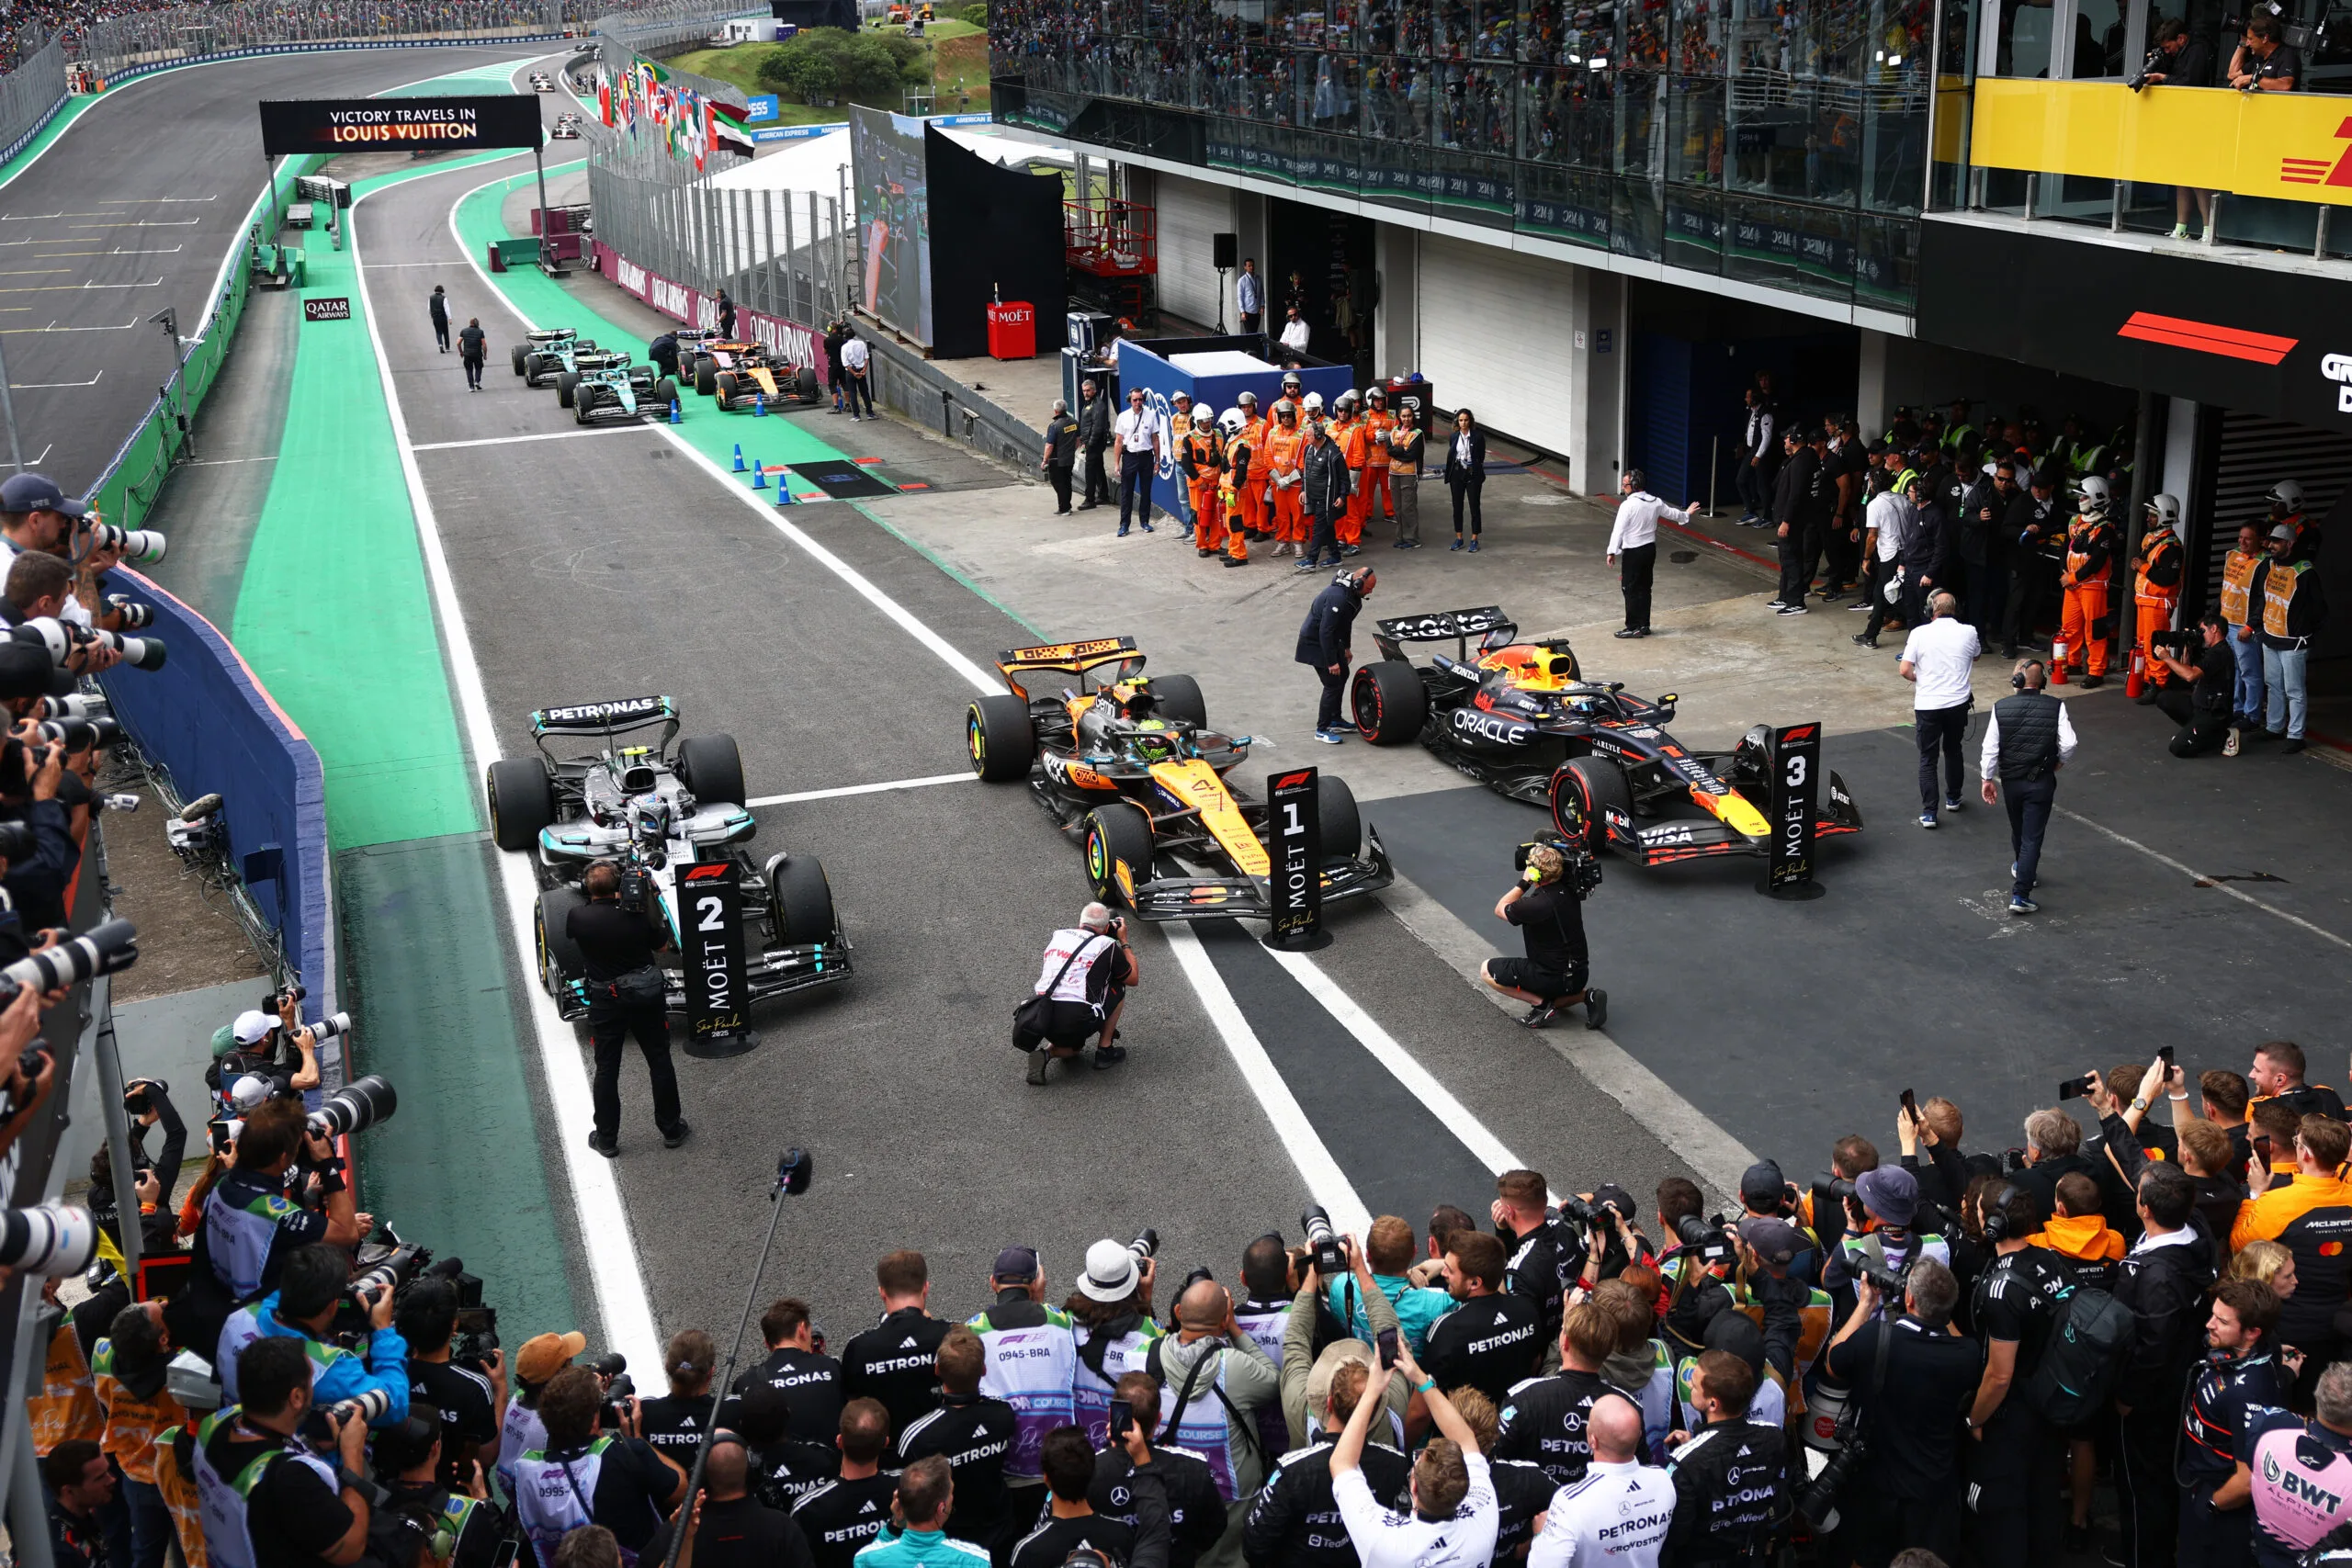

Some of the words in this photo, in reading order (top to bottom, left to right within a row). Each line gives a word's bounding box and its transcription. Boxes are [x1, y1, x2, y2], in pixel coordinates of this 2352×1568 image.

[330, 110, 391, 124] VICTORY
[396, 108, 454, 121] TRAVELS
[459, 107, 476, 120] IN
[956, 116, 985, 124] AMERICAN
[333, 124, 390, 142] LOUIS
[396, 122, 477, 141] VUITTON
[758, 130, 782, 140] AMERICAN
[784, 129, 808, 137] EXPRESS
[306, 301, 347, 314] QATAR
[652, 276, 666, 309] QATAR
[668, 283, 688, 320] AIRWAYS
[999, 309, 1031, 322] MOËT
[751, 315, 776, 356] QATAR
[777, 324, 815, 369] AIRWAYS
[1451, 664, 1480, 683] HONDA
[549, 698, 654, 720] PETRONAS
[1095, 691, 1116, 718] Gemini
[1454, 710, 1529, 746] ORACLE
[1591, 738, 1621, 754] CARLYLE
[1075, 770, 1098, 783] OXXO
[1786, 755, 1806, 787] 3
[1837, 792, 1850, 806] AT&T
[1283, 803, 1305, 837] 1
[1605, 810, 1630, 829] Mobil
[1785, 795, 1804, 857] MOËT
[1637, 826, 1693, 845] VISA
[1285, 844, 1306, 908] MOËT
[696, 896, 725, 931] 2
[703, 941, 730, 1010] MOËT
[1468, 1324, 1535, 1355] PETRONAS
[865, 1353, 938, 1375] PETRON
[999, 1348, 1050, 1362] 0945-BRA
[769, 1371, 832, 1389] RONAS
[650, 1432, 704, 1445] PETRON
[1177, 1428, 1223, 1439] COURSE
[2267, 1485, 2326, 1522] ALPINE
[2281, 1471, 2342, 1516] BWT
[824, 1517, 890, 1542] PETRON
